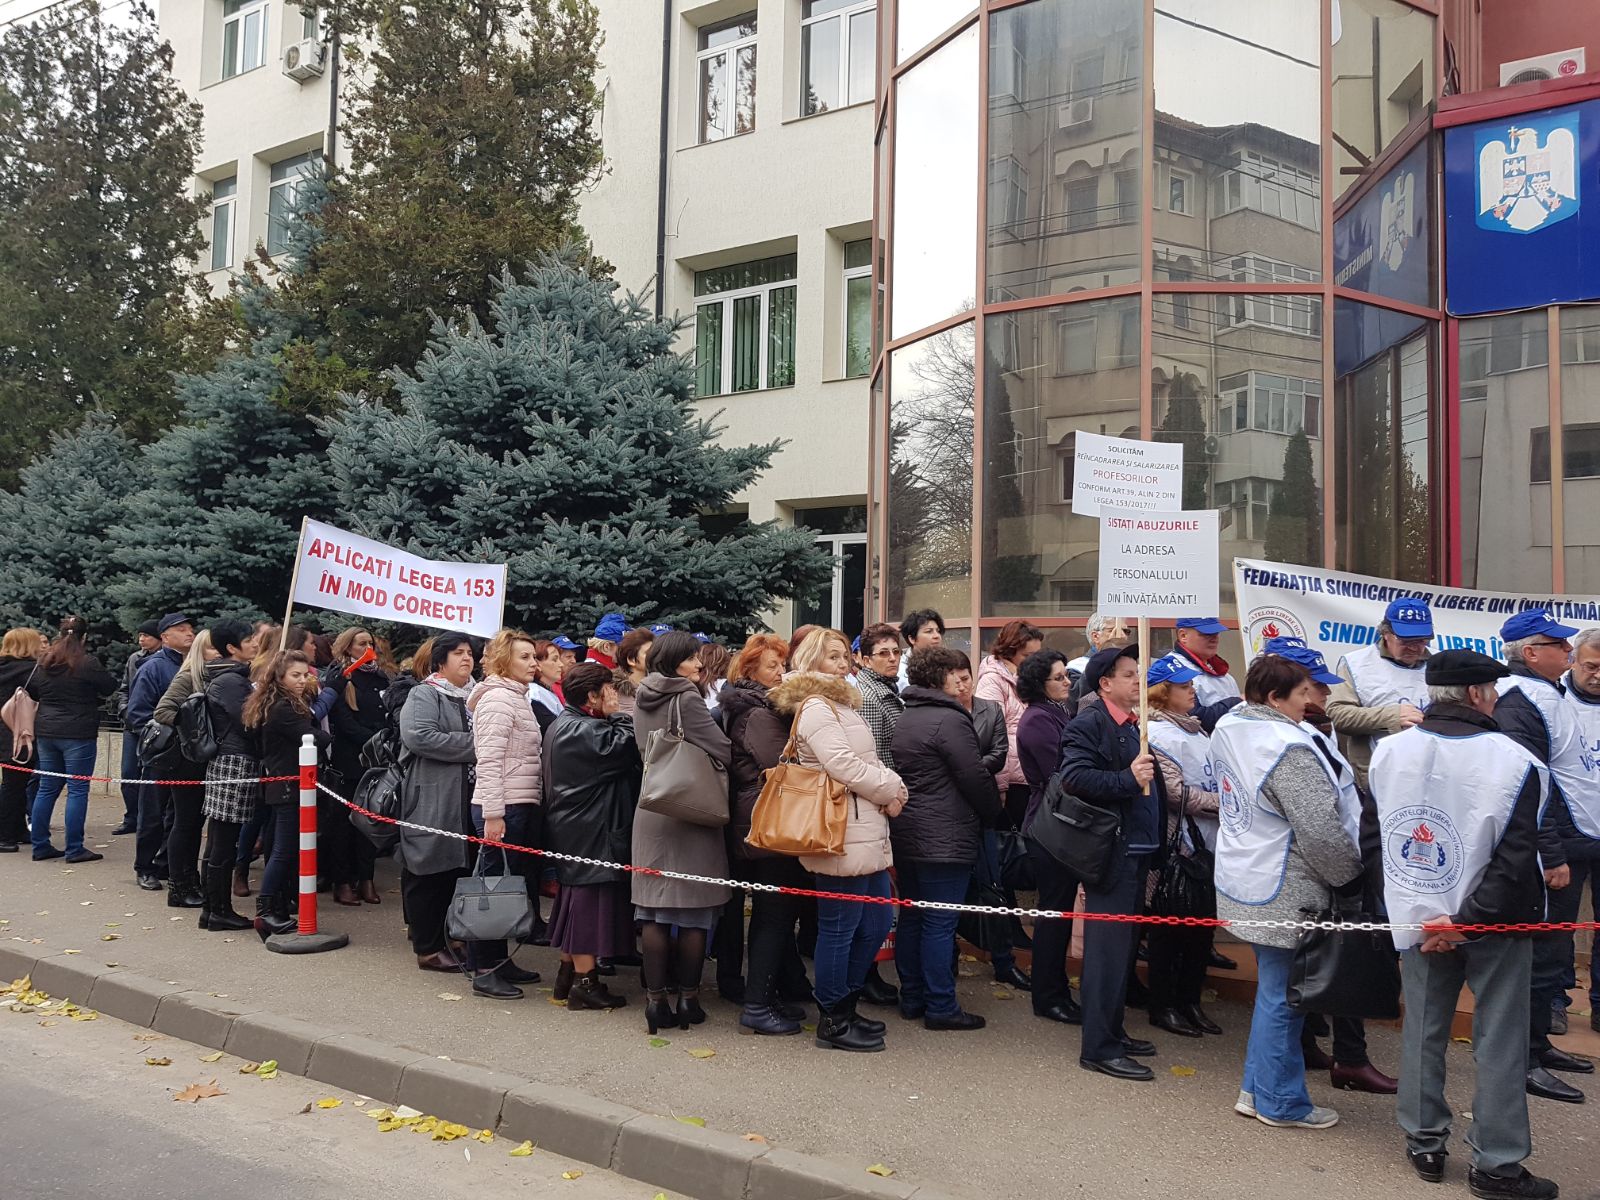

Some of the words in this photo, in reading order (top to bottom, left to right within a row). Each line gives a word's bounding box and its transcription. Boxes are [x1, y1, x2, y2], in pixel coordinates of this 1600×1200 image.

[1133, 461, 1180, 471] SALARIZAREA
[1093, 469, 1158, 485] PROFESORILOR
[1078, 481, 1111, 493] CONFORM
[1093, 496, 1114, 505] LEGEA
[1136, 520, 1199, 531] ABUZURILE
[1121, 544, 1131, 554] LA
[1134, 544, 1176, 556] ADRESA
[1113, 568, 1188, 580] PERSONALULUI
[398, 565, 457, 595] LEGEA
[463, 578, 495, 598] 153
[318, 569, 342, 596] ÎN
[346, 579, 388, 607] MOD
[393, 593, 473, 624] CORECT!
[1244, 567, 1324, 596] FEDERAȚIA
[1434, 593, 1485, 612] LIBERE
[1488, 597, 1518, 614] DIN
[1107, 592, 1121, 603] DIN
[1398, 609, 1426, 621] FSLI
[1319, 620, 1381, 645] SINDI
